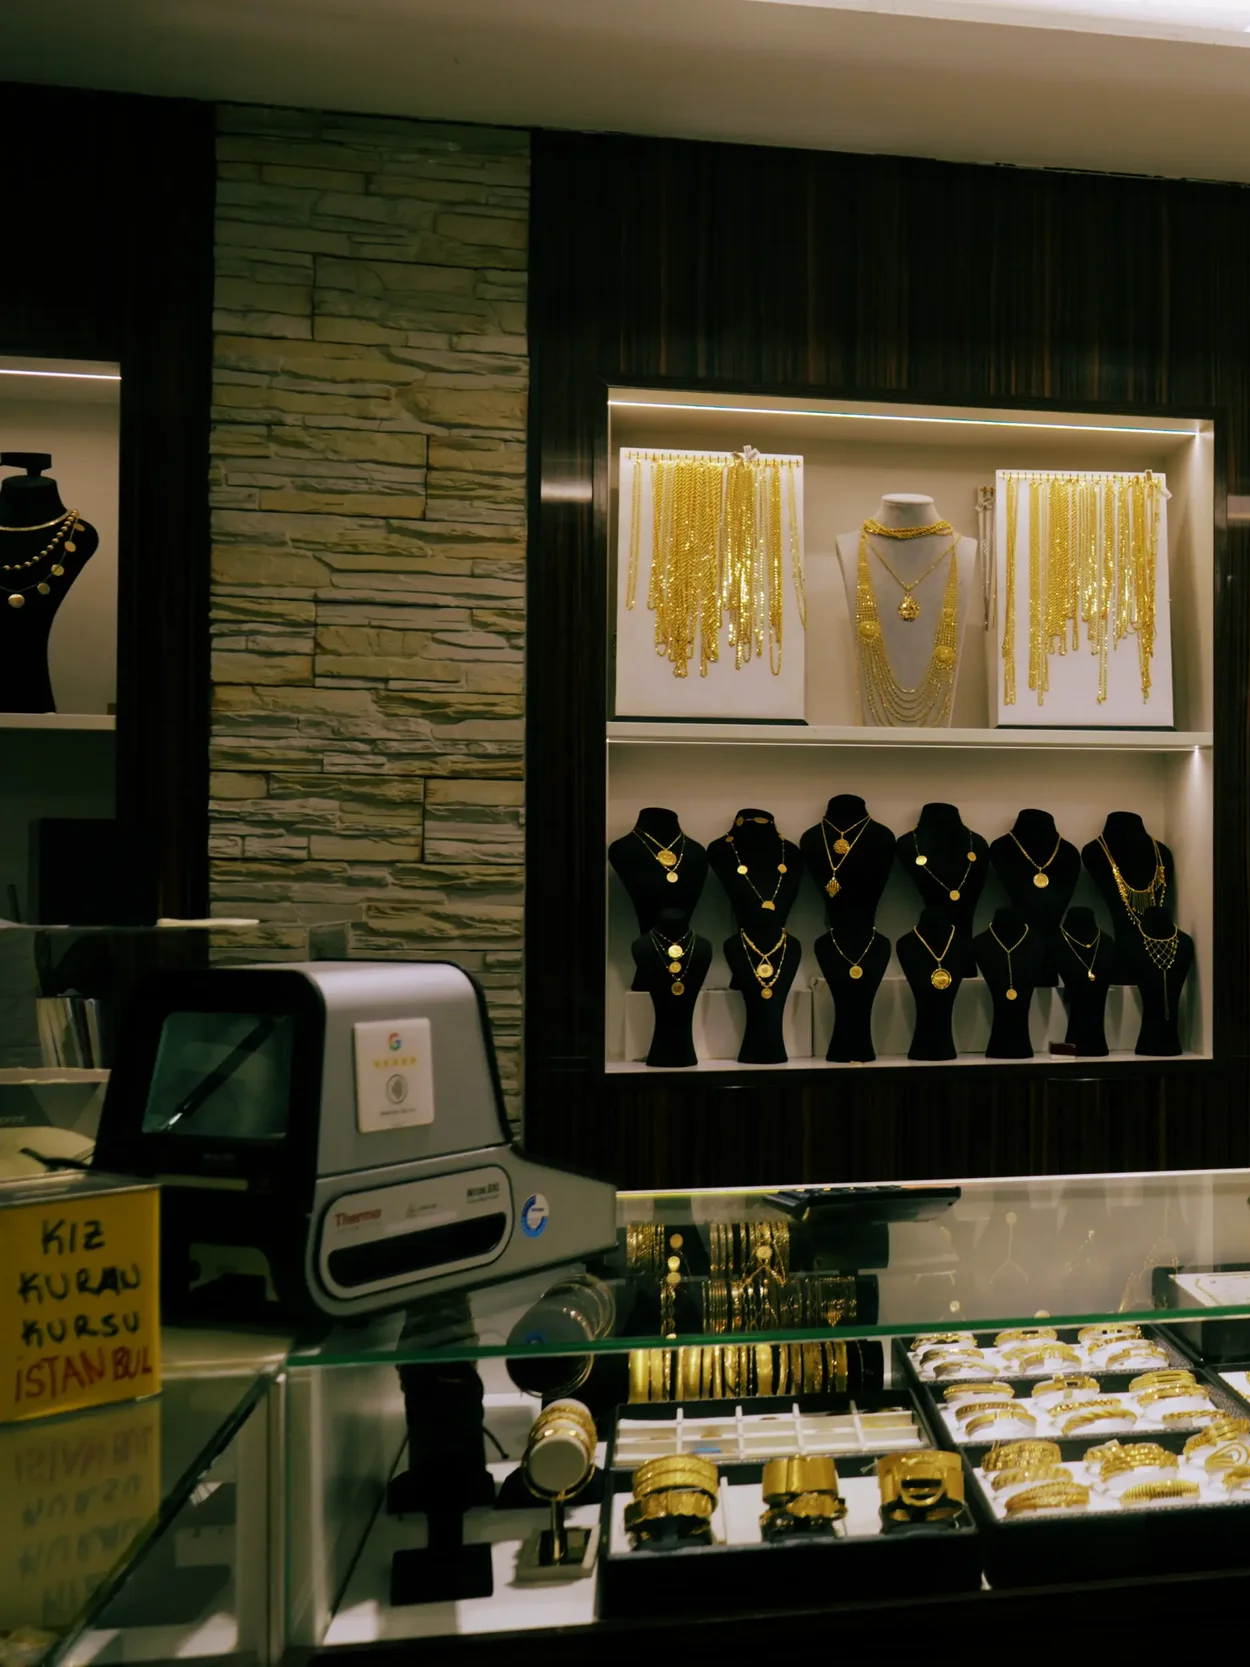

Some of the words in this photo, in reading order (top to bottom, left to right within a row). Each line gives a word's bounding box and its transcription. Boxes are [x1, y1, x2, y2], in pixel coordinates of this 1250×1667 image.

[335, 1208, 382, 1227] Thermo
[41, 1219, 105, 1255] KIZ
[21, 1311, 140, 1348] KURSU
